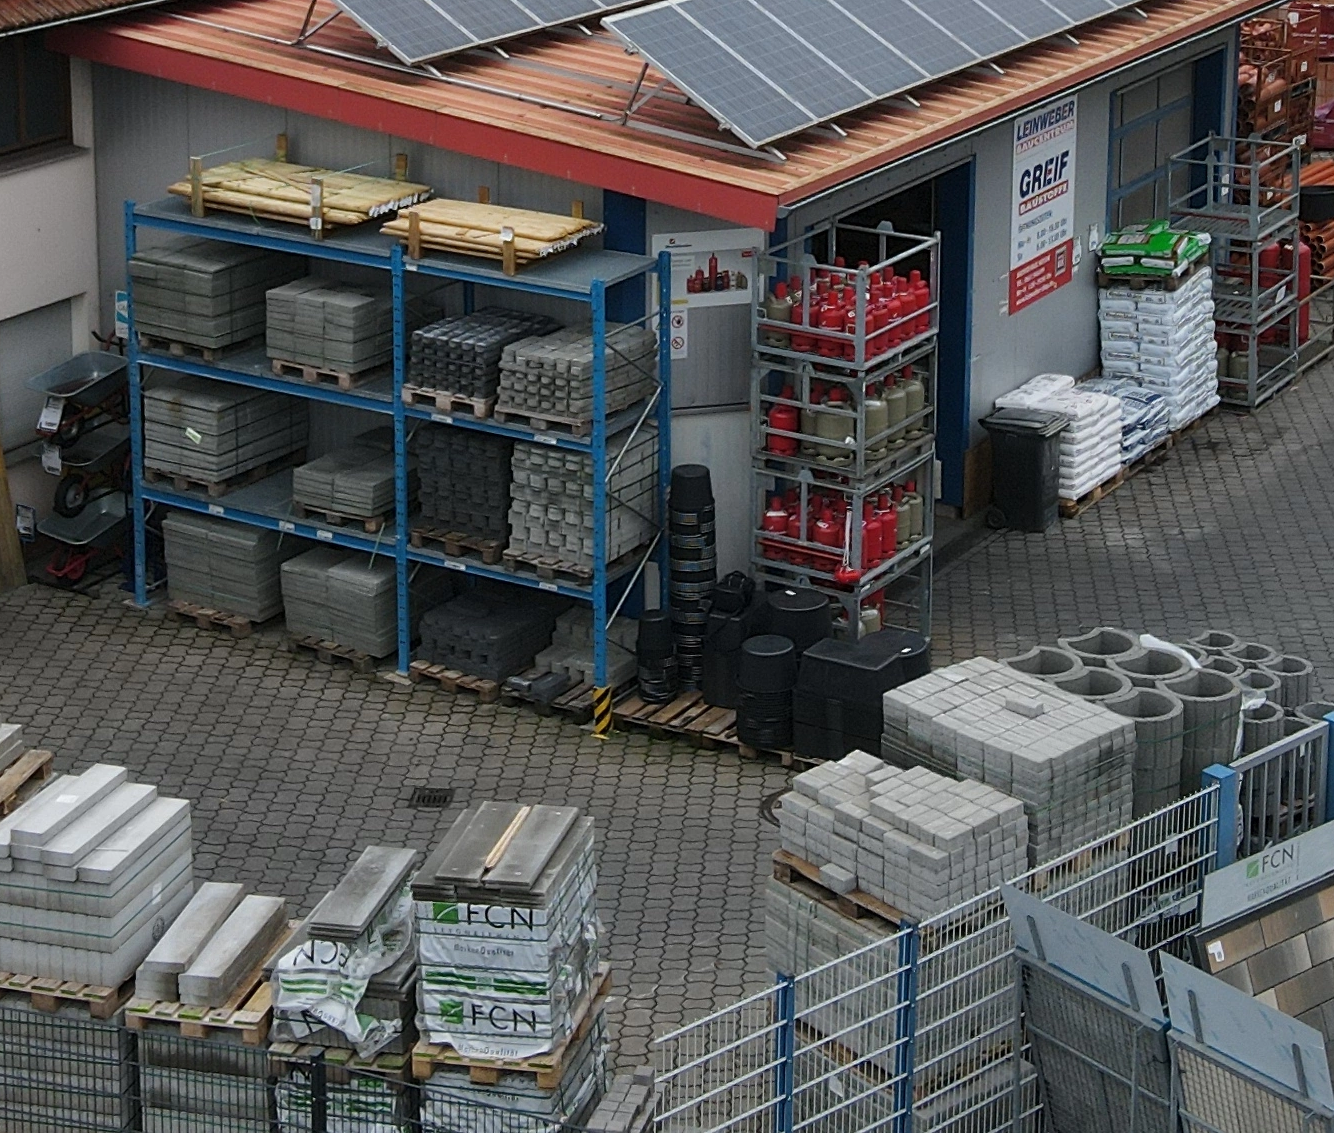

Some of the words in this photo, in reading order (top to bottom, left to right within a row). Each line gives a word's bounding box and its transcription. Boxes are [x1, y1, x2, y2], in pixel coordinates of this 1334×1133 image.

[1017, 100, 1075, 142] LEINWEBER
[1019, 150, 1070, 199] GREIF
[1020, 182, 1068, 214] BAUSTOFFE
[1262, 844, 1294, 873] FCN
[466, 903, 534, 932] FCN
[471, 1003, 537, 1033] FCN
